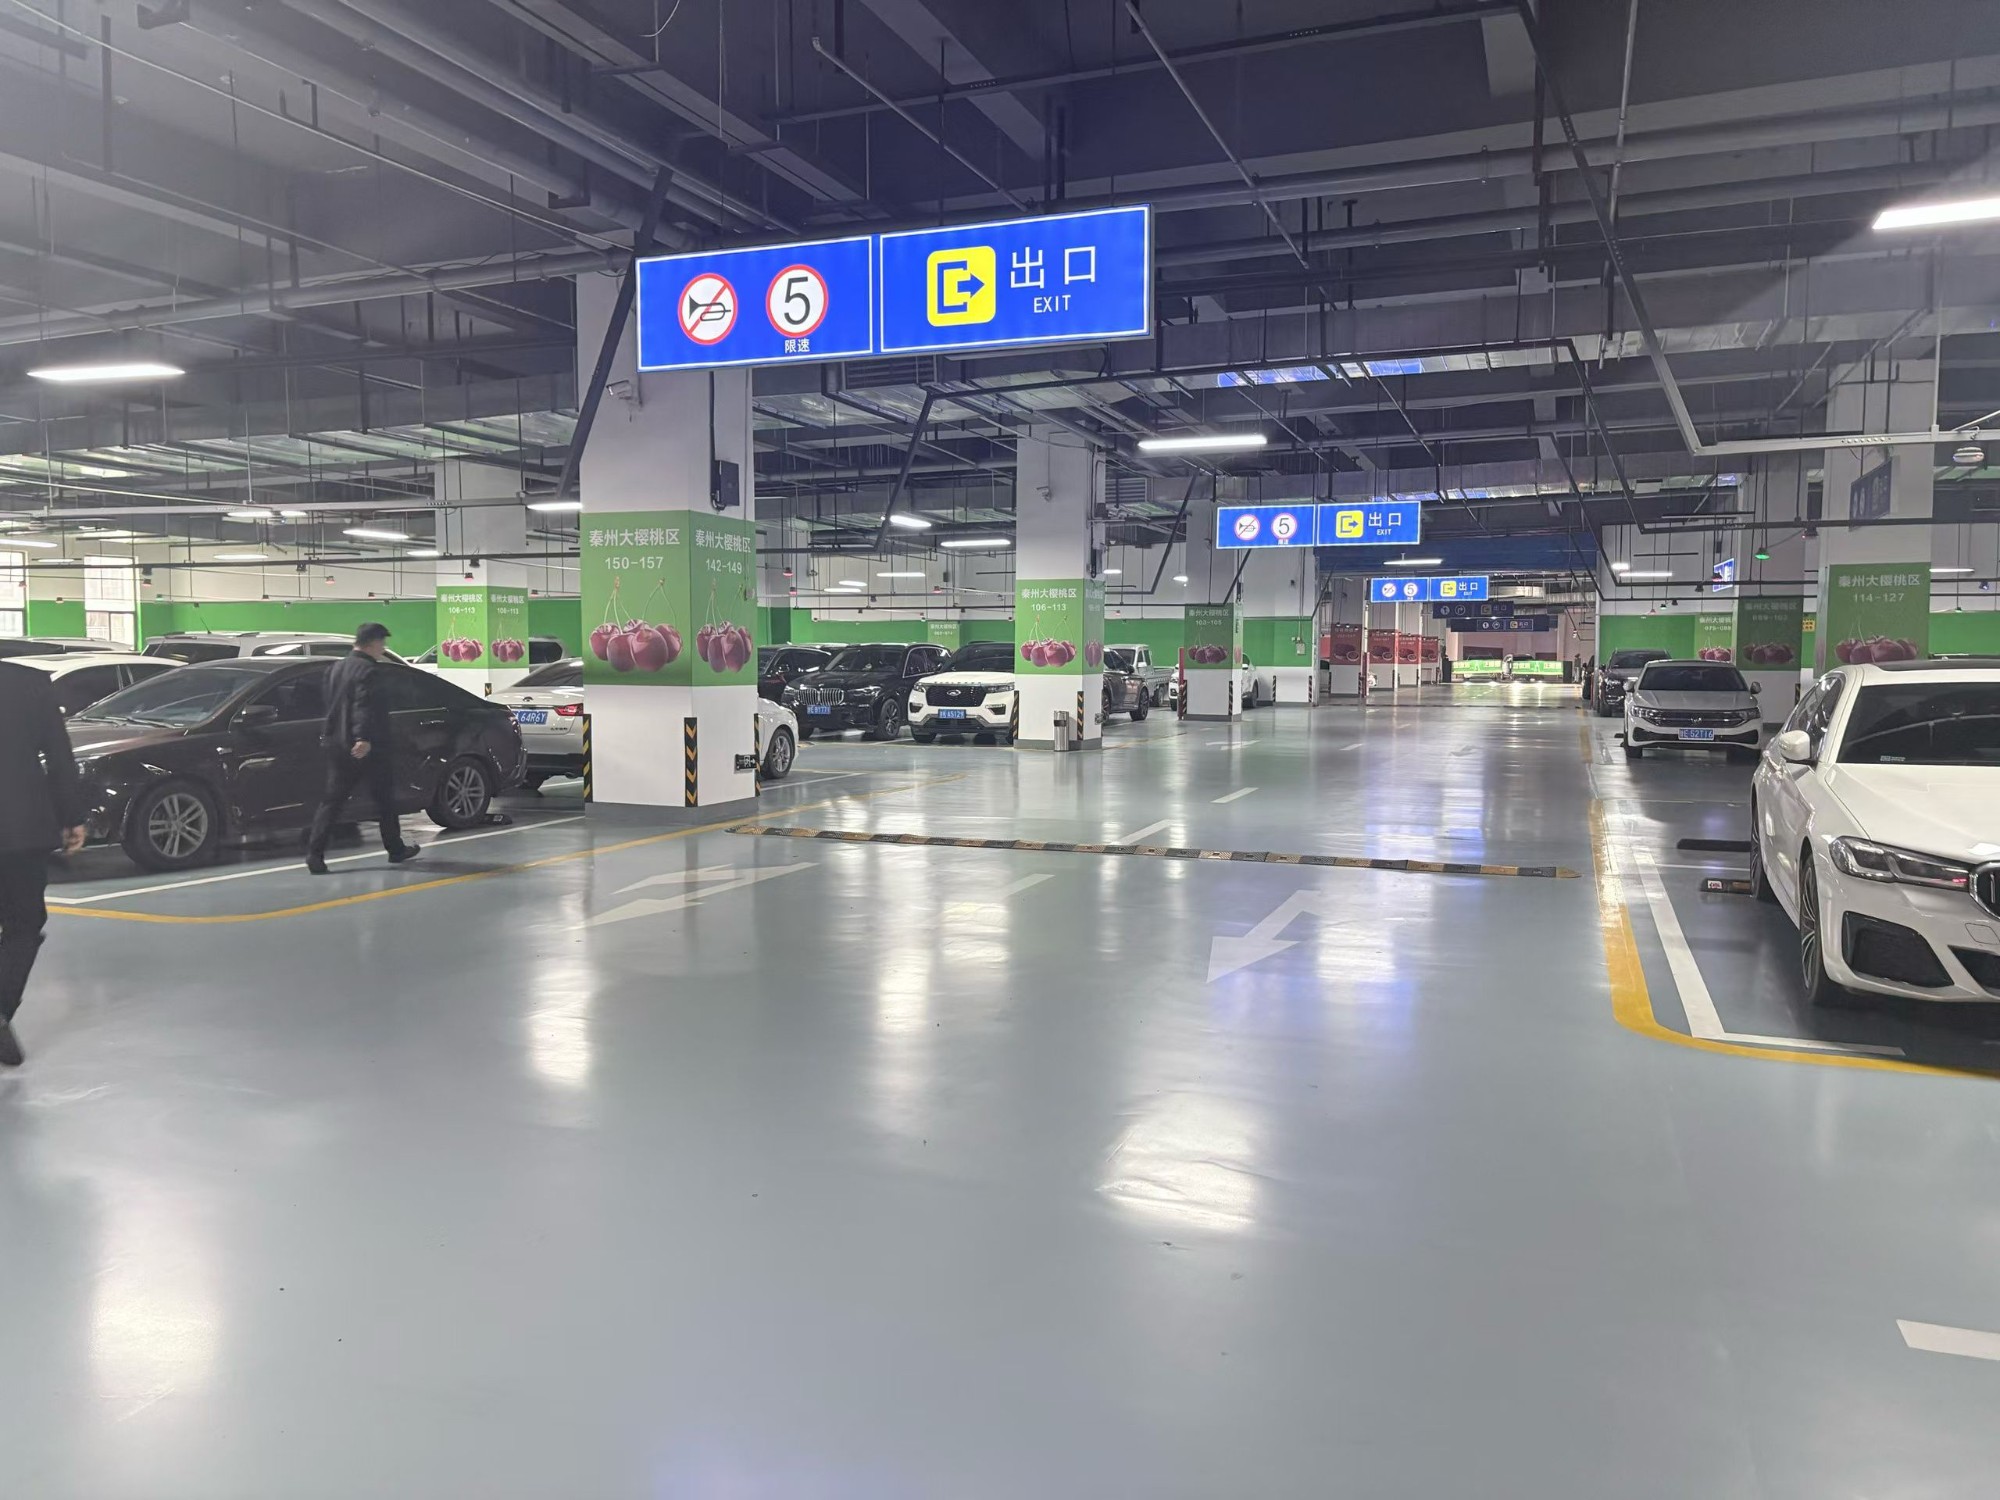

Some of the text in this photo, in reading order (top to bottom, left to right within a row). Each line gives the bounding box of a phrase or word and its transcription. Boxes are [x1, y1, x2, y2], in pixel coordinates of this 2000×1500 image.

[1010, 246, 1097, 290] 出口
[783, 276, 811, 325] 5
[1033, 295, 1071, 314] EXIT
[784, 338, 810, 354] 限速
[1278, 517, 1290, 535] 5
[1368, 512, 1402, 528] 出口
[589, 528, 680, 547] 秦州大樱桃区
[1377, 528, 1392, 536] EXIT
[695, 529, 751, 553] 秦州大樱桃区
[605, 557, 664, 570] 150-157
[705, 559, 743, 575] 142-149
[1459, 582, 1478, 591] 出口
[1838, 574, 1921, 588] 秦州大樱桃区
[1021, 588, 1078, 599] 秦州大樱桃区
[1407, 584, 1415, 595] 5
[1854, 592, 1905, 603] 114-127
